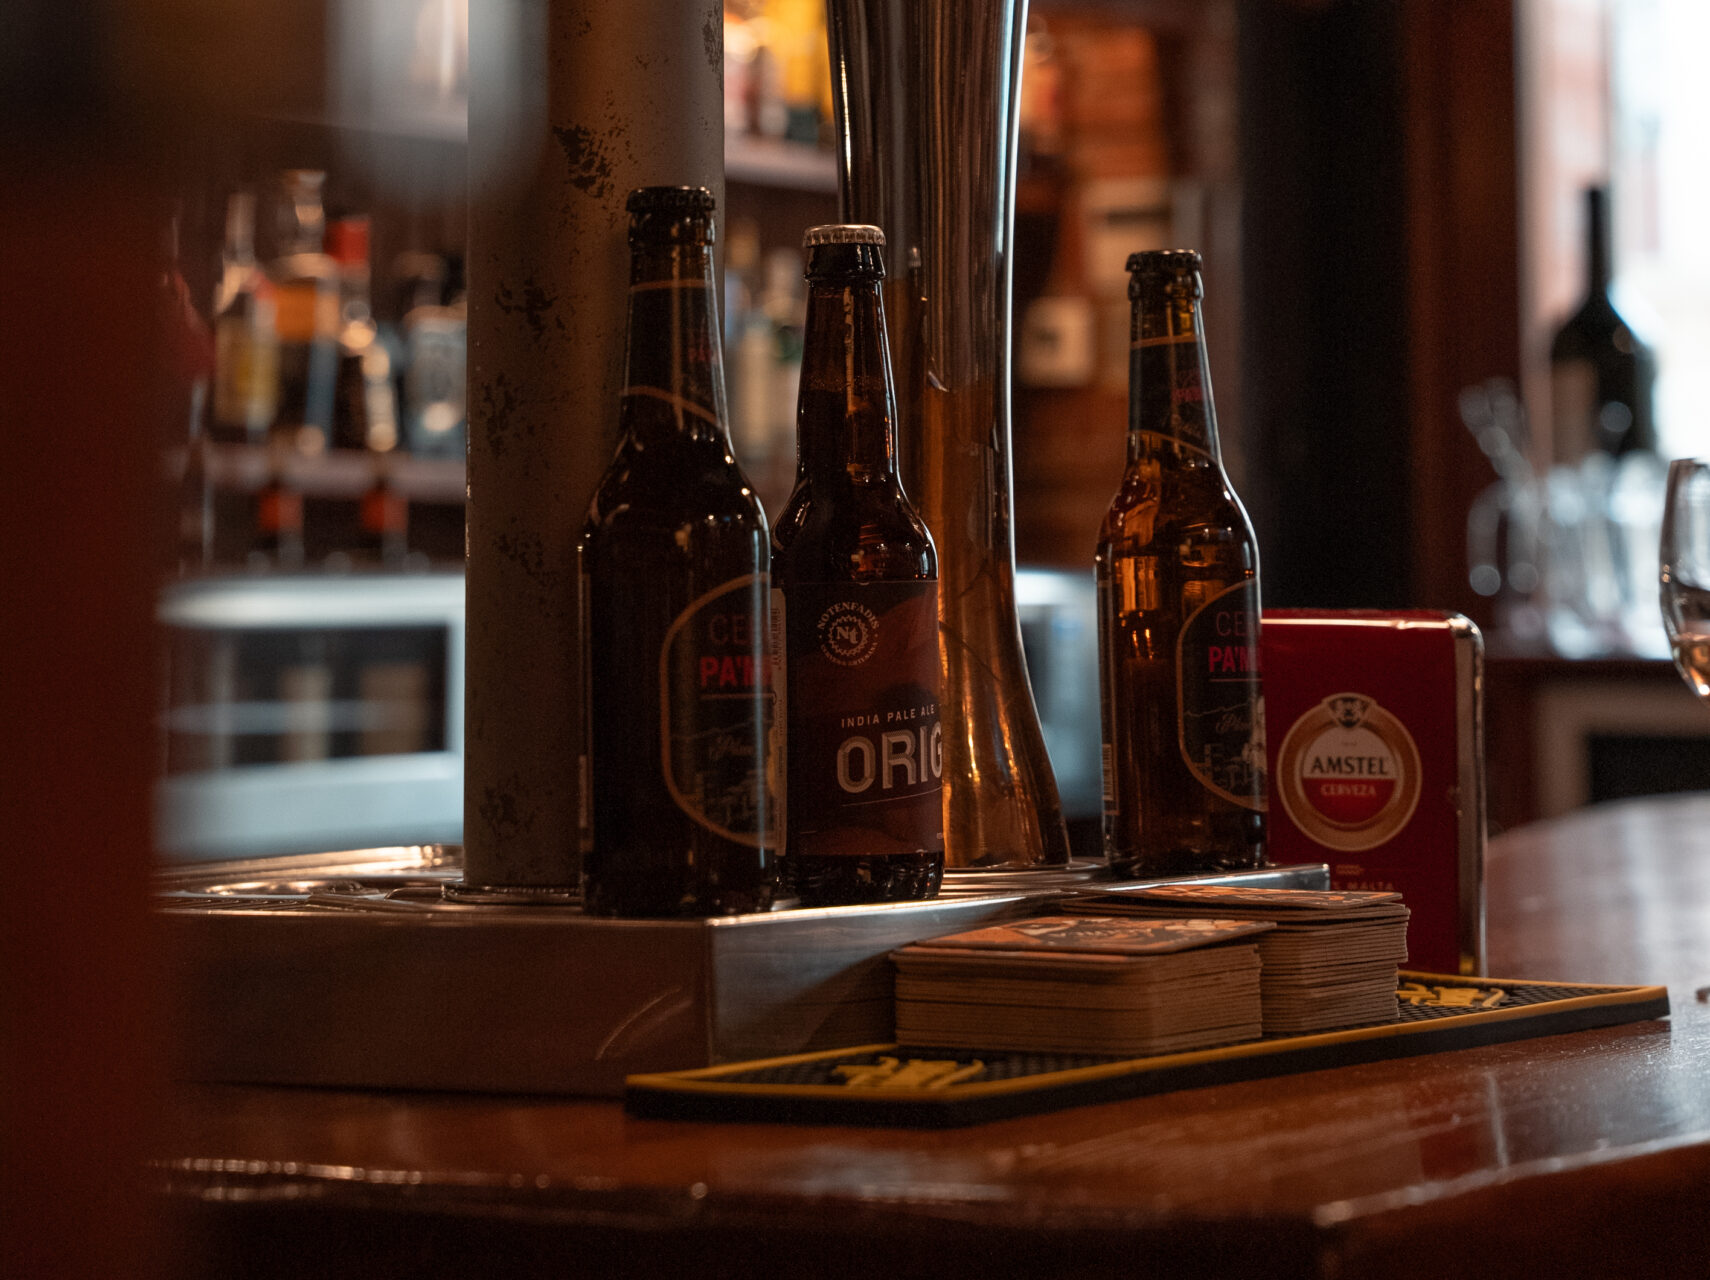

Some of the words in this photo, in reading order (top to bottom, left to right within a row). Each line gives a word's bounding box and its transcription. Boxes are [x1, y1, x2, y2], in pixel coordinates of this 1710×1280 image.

[816, 601, 880, 631] NOTENFADIS
[841, 714, 880, 729] INDIA
[887, 708, 917, 723] PALE
[920, 703, 936, 717] ALE
[836, 721, 943, 795] ORIG
[1310, 755, 1388, 776] AMSTEL
[1320, 783, 1378, 798] CERVEZA
